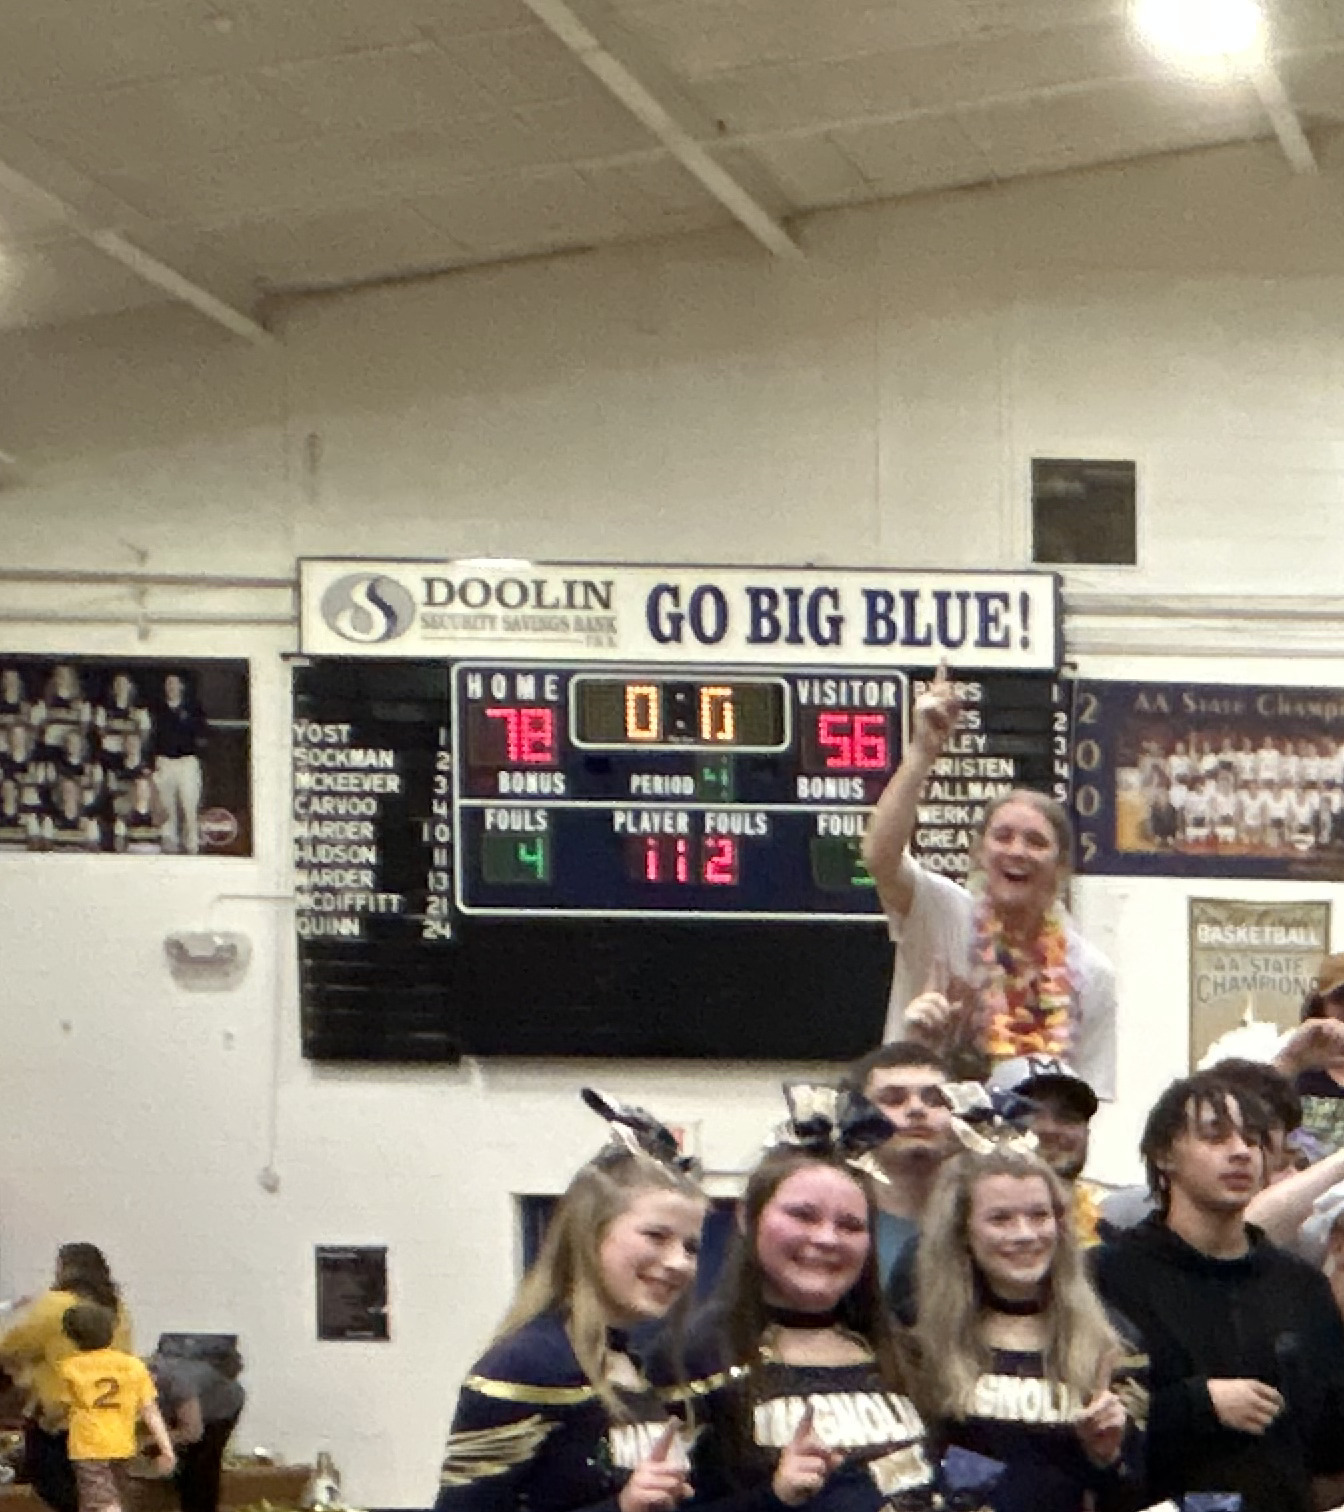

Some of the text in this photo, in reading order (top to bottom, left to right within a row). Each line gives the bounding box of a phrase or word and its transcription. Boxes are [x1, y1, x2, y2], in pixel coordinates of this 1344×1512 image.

[421, 577, 614, 609] DOOLIN
[646, 584, 1031, 650] GO BIG BLUE!
[466, 673, 560, 701] HOME
[797, 679, 897, 708] VISITOR
[1133, 692, 1170, 714] AA
[293, 725, 350, 743] YOST
[1053, 712, 1067, 732] 2
[485, 707, 553, 763] 78
[818, 713, 888, 769] 56
[498, 771, 565, 795] BONUS
[630, 774, 695, 797] PERIOD
[796, 776, 864, 799] BONUS
[484, 809, 548, 831] FOULS
[613, 811, 767, 835] PLAYER FOULS
[817, 813, 867, 836] FOUL
[518, 837, 544, 879] 4
[1197, 924, 1322, 947] BASKETBALL
[1250, 956, 1305, 976] STATE
[93, 1376, 121, 1410] 2
